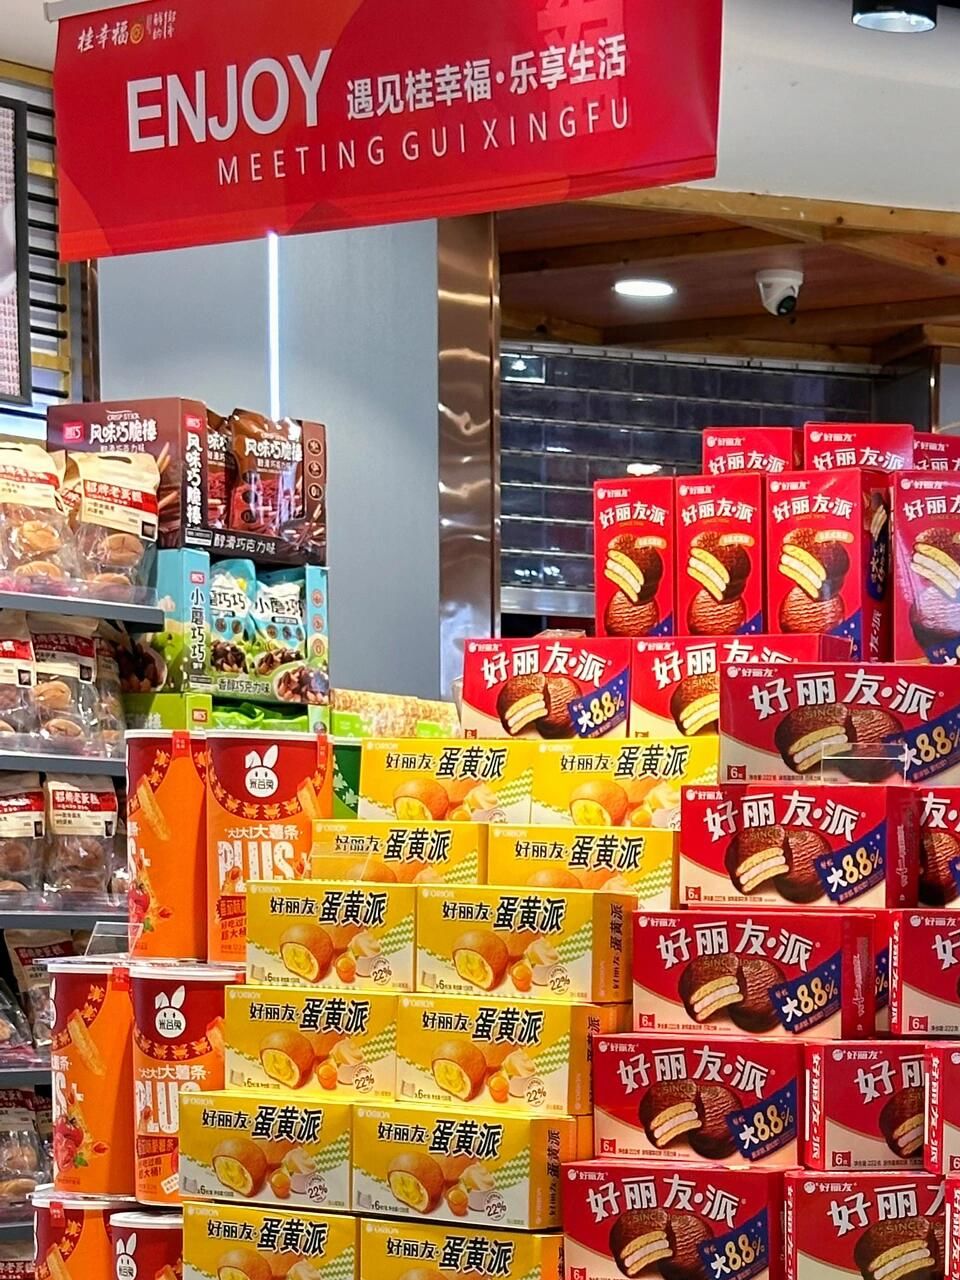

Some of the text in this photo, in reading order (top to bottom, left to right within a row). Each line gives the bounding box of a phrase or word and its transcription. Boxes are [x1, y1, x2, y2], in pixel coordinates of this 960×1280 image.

[77, 20, 129, 53] 桂幸福
[127, 48, 333, 152] ENJOY
[347, 33, 627, 121] 遇见桂幸福·乐享生活
[218, 136, 385, 186] MEETING
[89, 420, 157, 446] 风味巧脆棒
[186, 432, 203, 527] 风味巧脆棒
[600, 502, 665, 529] 好丽友·派
[682, 498, 753, 525] 好丽友·派
[773, 494, 852, 522] 好丽友·派
[481, 641, 606, 688] 好丽友·派
[749, 668, 935, 721] 好丽友·派
[704, 790, 859, 842] 好丽友·派
[657, 920, 813, 972] 好丽友·派
[620, 1047, 768, 1098] 好丽友·派
[587, 1176, 738, 1229] 好丽友·派
